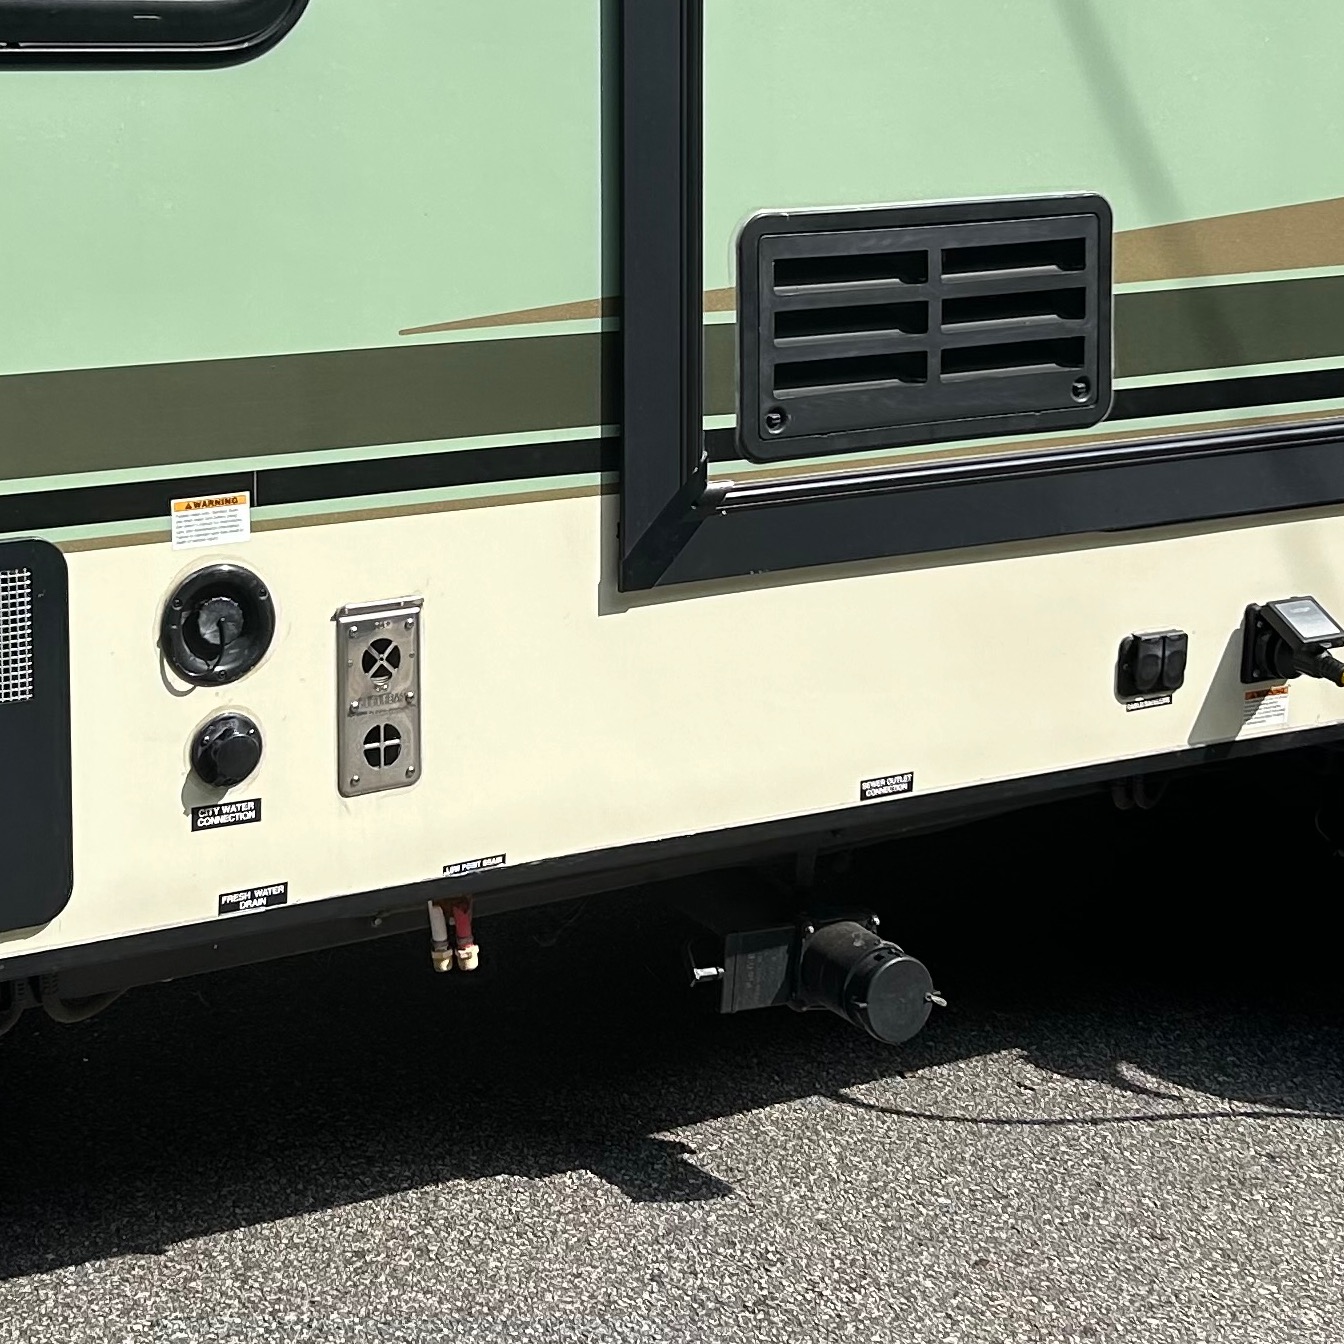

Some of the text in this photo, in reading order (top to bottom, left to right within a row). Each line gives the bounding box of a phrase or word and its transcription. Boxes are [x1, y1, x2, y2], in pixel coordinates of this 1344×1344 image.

[193, 496, 238, 509] WARNING
[198, 801, 255, 818] CITY WATER
[197, 810, 256, 827] CONNECTION
[221, 884, 285, 905] FRESH WATER
[239, 896, 267, 910] DRAIN
